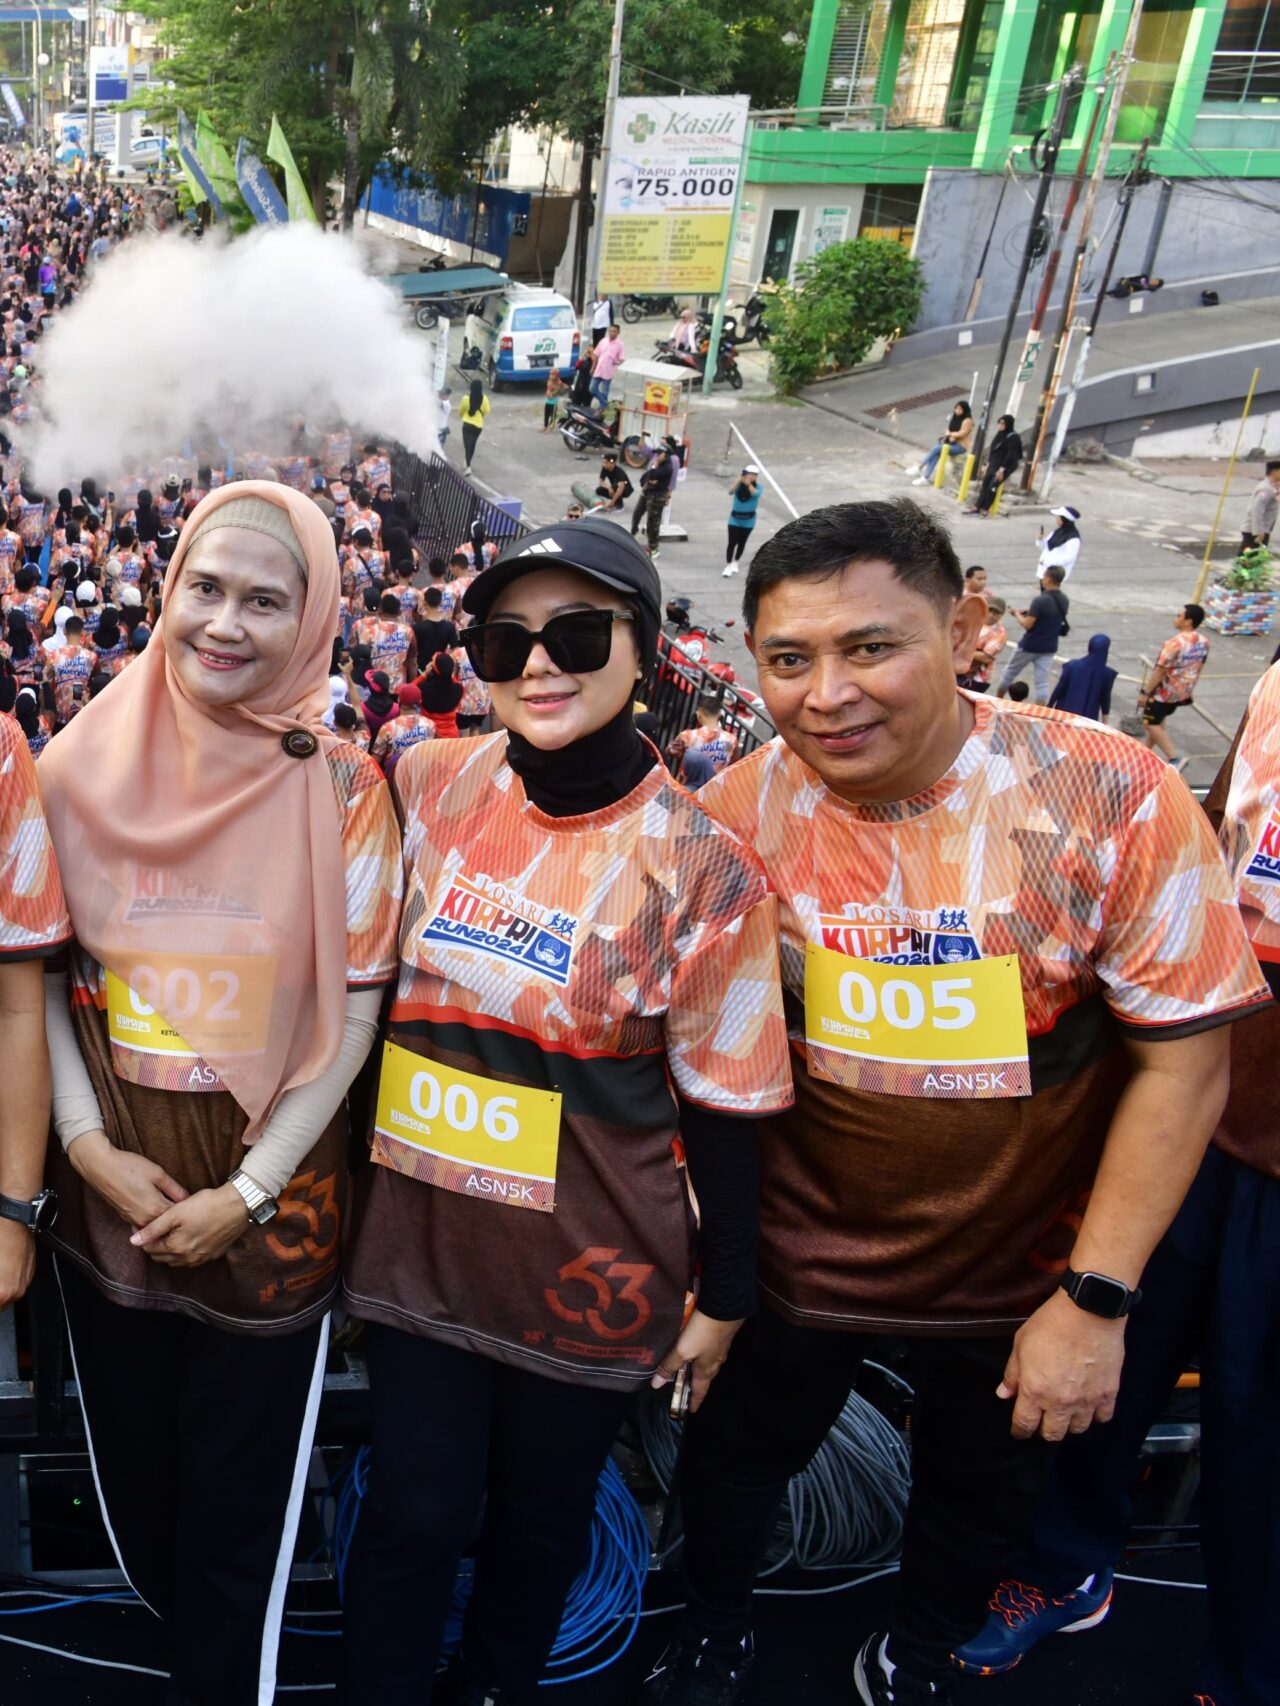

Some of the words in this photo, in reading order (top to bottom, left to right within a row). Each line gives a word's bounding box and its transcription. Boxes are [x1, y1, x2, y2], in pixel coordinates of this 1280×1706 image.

[663, 111, 738, 135] Kasih
[637, 167, 677, 177] RAPID
[679, 167, 737, 176] ANTIGEN
[637, 178, 734, 197] 75.000
[438, 888, 538, 944] KORPRI
[482, 877, 545, 927] LOSARI
[854, 905, 932, 929] LOSARI
[430, 917, 525, 956] RUN2024
[822, 927, 932, 958] KORPRI
[128, 964, 241, 1021] 002
[838, 971, 976, 1030] 005
[923, 1072, 1007, 1090] ASN5K
[409, 1071, 520, 1142] 006
[465, 1174, 535, 1201] ASN5K
[543, 1247, 656, 1341] 53
